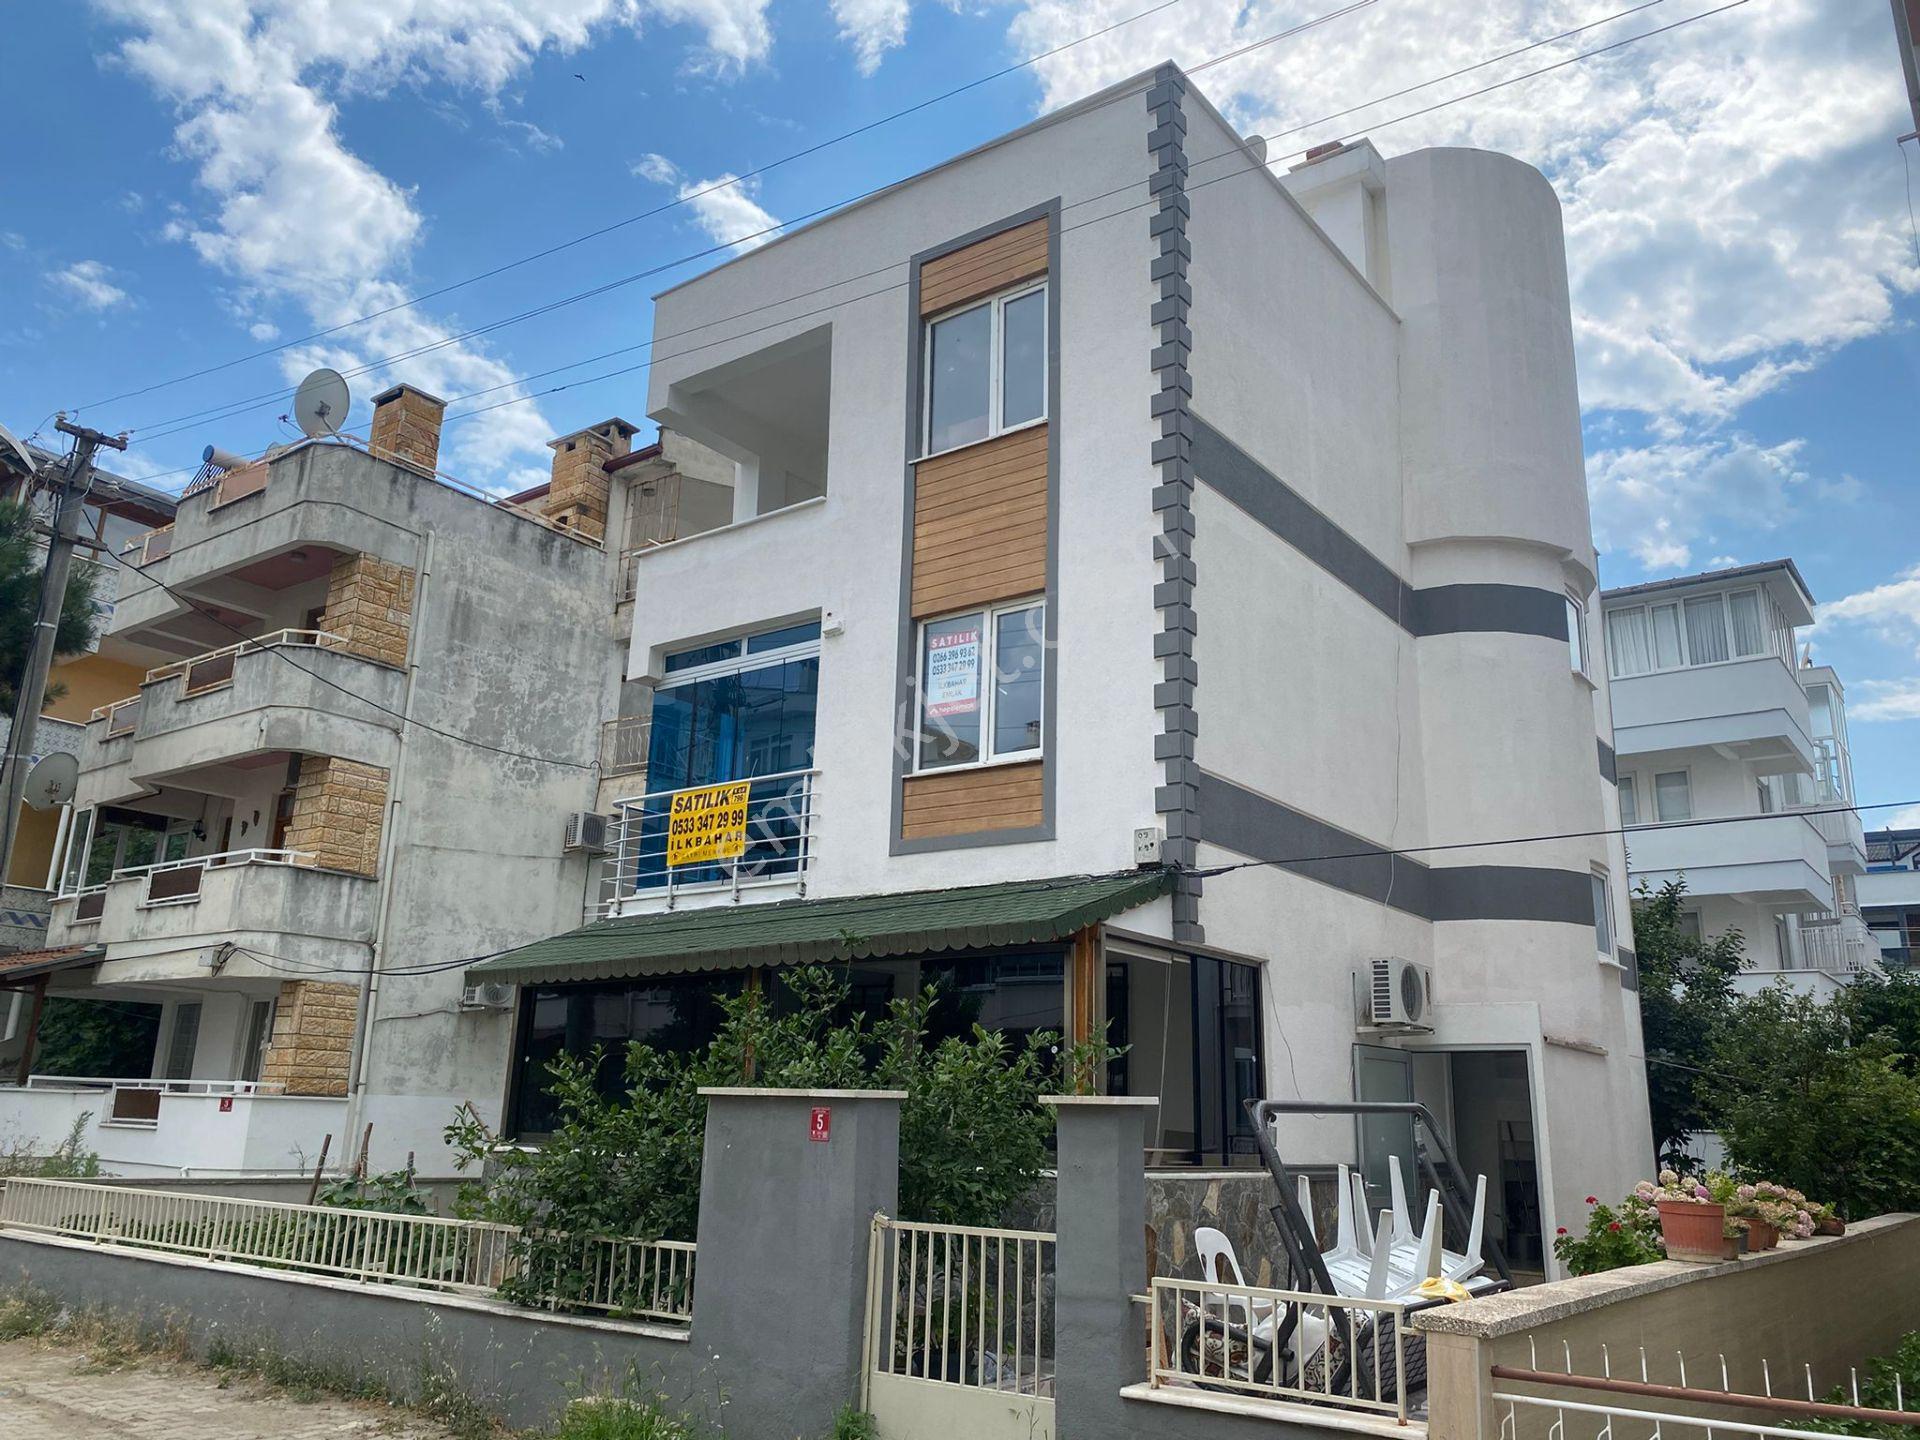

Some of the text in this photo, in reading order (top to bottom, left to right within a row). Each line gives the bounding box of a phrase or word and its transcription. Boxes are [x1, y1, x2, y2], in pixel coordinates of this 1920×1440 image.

[931, 631, 977, 648] SATILIK
[932, 651, 947, 663] 0266
[948, 648, 960, 660] 396
[960, 647, 967, 658] 93
[932, 664, 946, 675] 0533
[967, 658, 975, 668] 99
[674, 789, 730, 814] SATILIK
[672, 809, 744, 836] 0533 347 29 99
[671, 831, 742, 850] İLKBAHAR
[816, 1113, 824, 1130] 5
